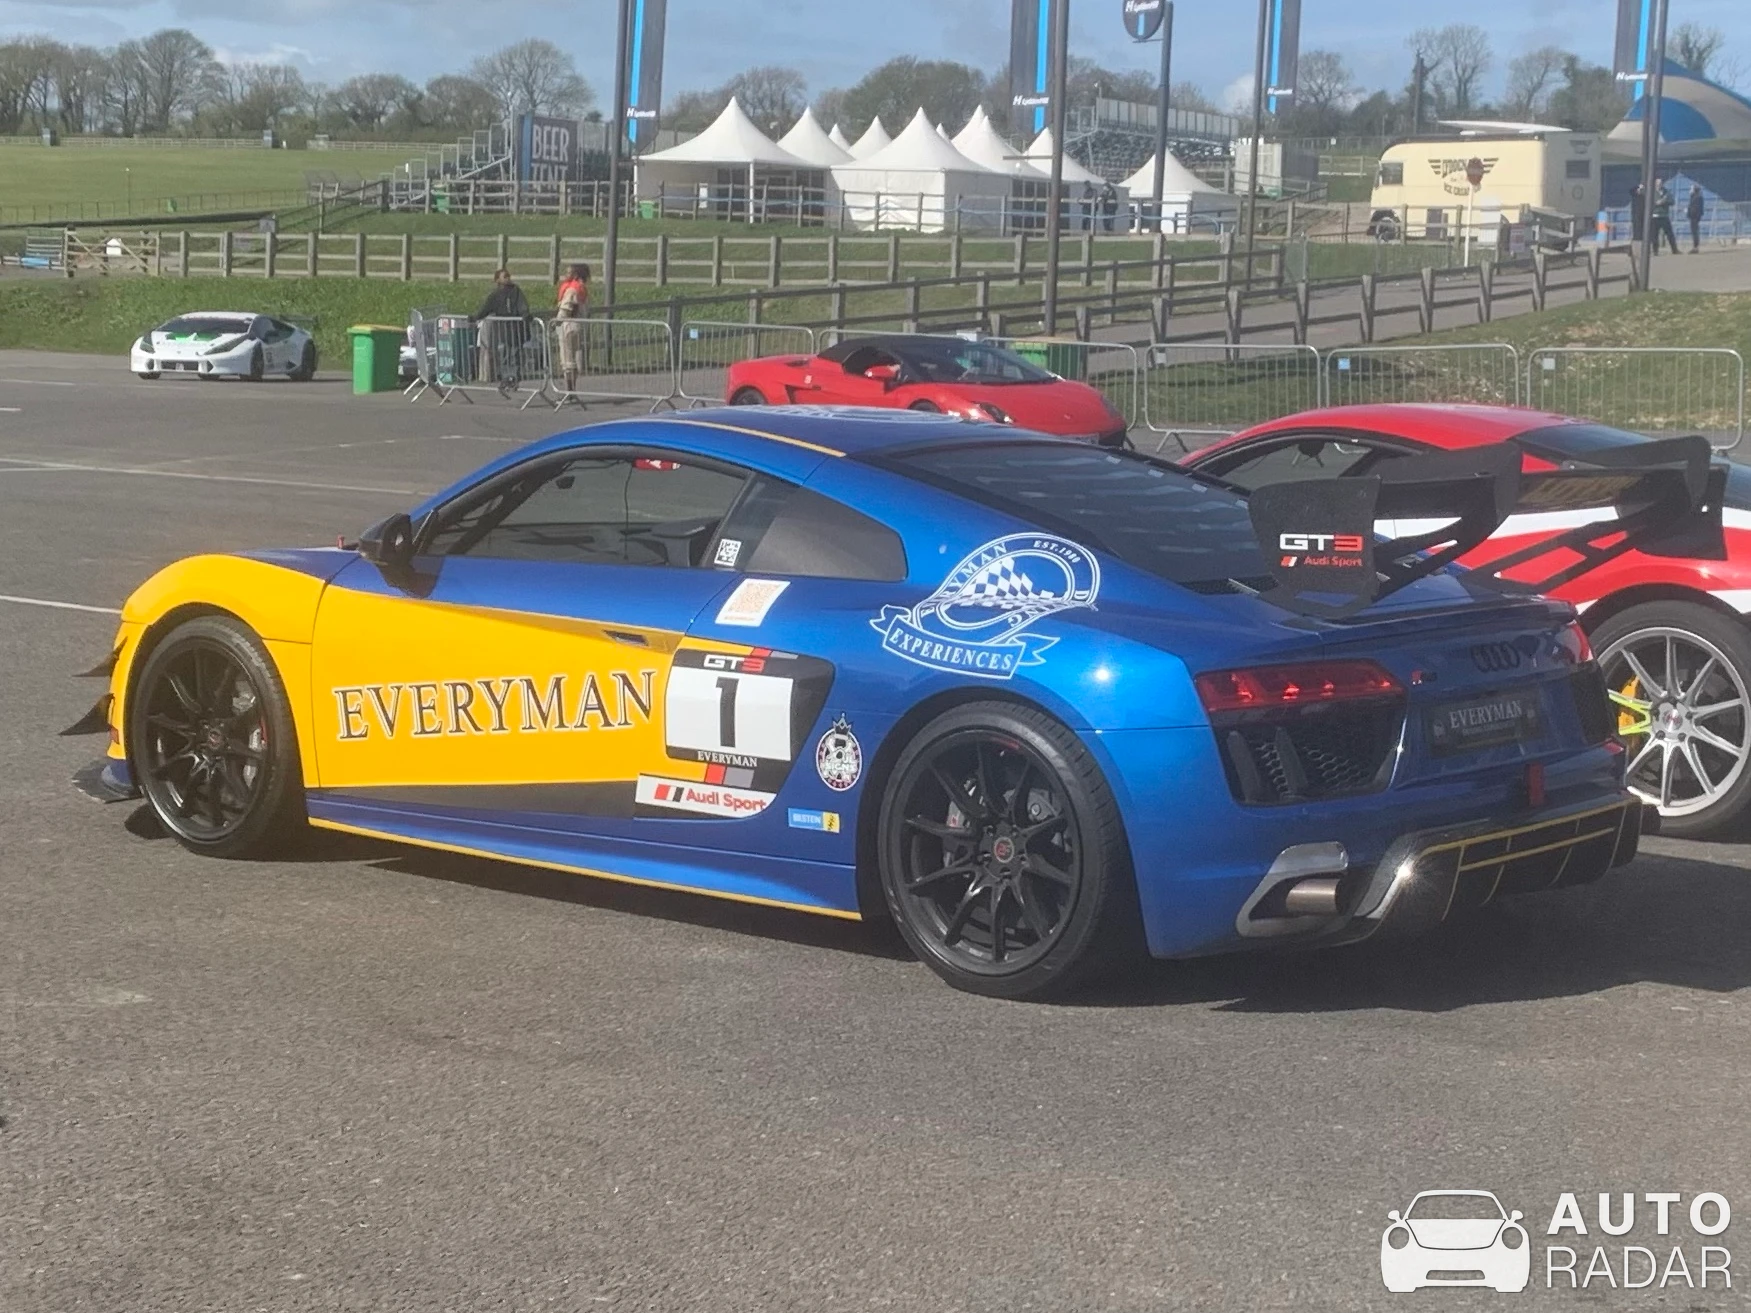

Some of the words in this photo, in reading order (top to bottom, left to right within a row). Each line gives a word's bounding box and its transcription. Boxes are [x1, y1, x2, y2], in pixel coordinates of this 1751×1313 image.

[532, 124, 570, 162] BEER
[1280, 533, 1363, 551] GT3
[1303, 556, 1330, 565] Audi
[1331, 556, 1363, 567] Sport
[889, 627, 1014, 670] EXPERIENCES
[703, 654, 766, 673] GT3
[333, 670, 657, 740] EVERYMAN
[715, 676, 740, 747] 1
[1449, 700, 1522, 729] EVERYMAN
[697, 750, 758, 767] EVERYMAN
[686, 788, 720, 804] Audi
[723, 793, 768, 811] Sport
